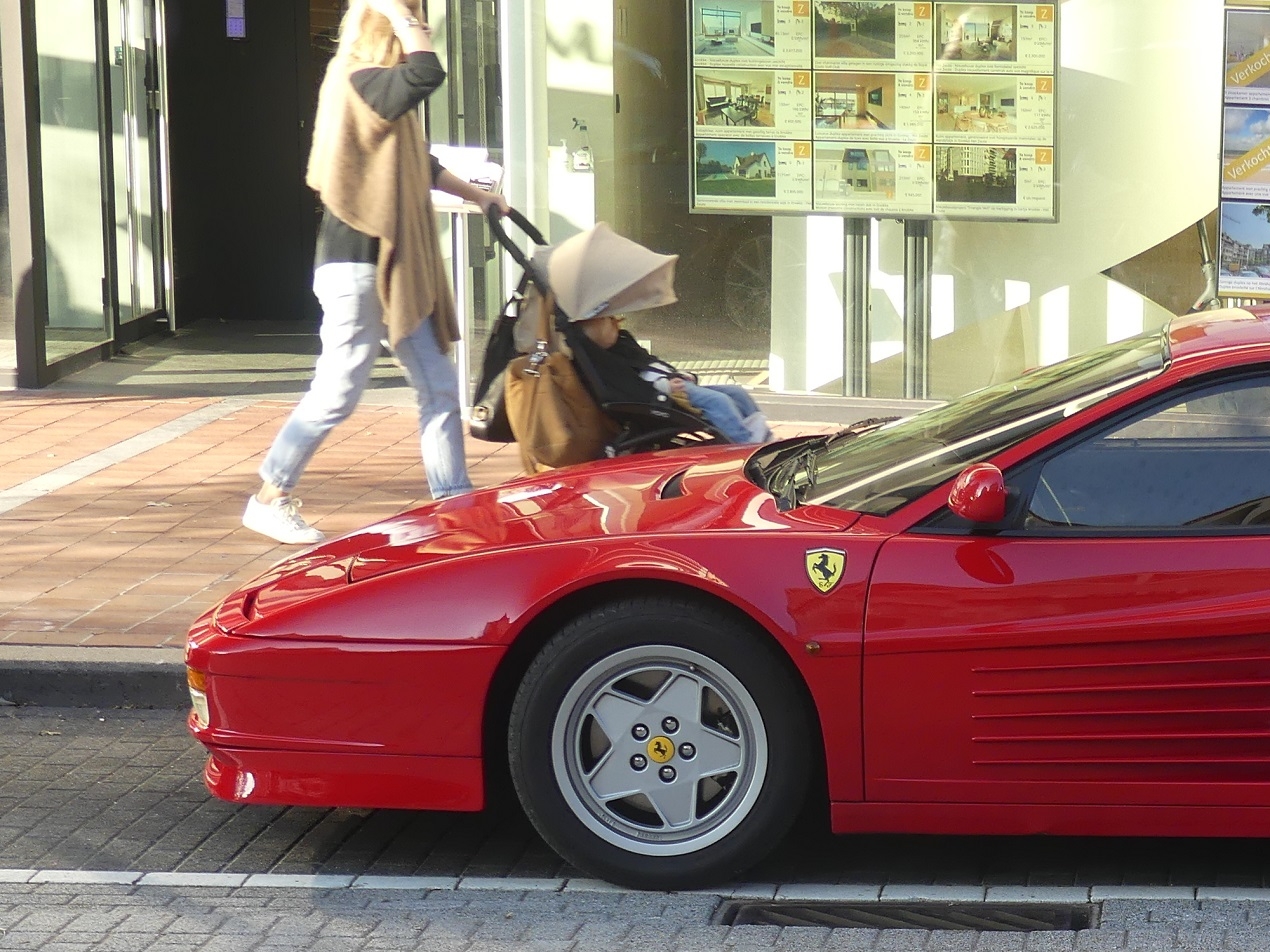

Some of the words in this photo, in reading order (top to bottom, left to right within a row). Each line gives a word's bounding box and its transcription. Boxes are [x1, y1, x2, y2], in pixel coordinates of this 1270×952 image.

[798, 4, 804, 14] Z
[920, 6, 926, 17] Z
[1041, 9, 1047, 19] Z
[799, 75, 805, 85] Z
[920, 78, 926, 88] Z
[1041, 81, 1047, 90] Z
[799, 146, 806, 155] Z
[920, 149, 926, 158] Z
[1041, 152, 1047, 161] Z
